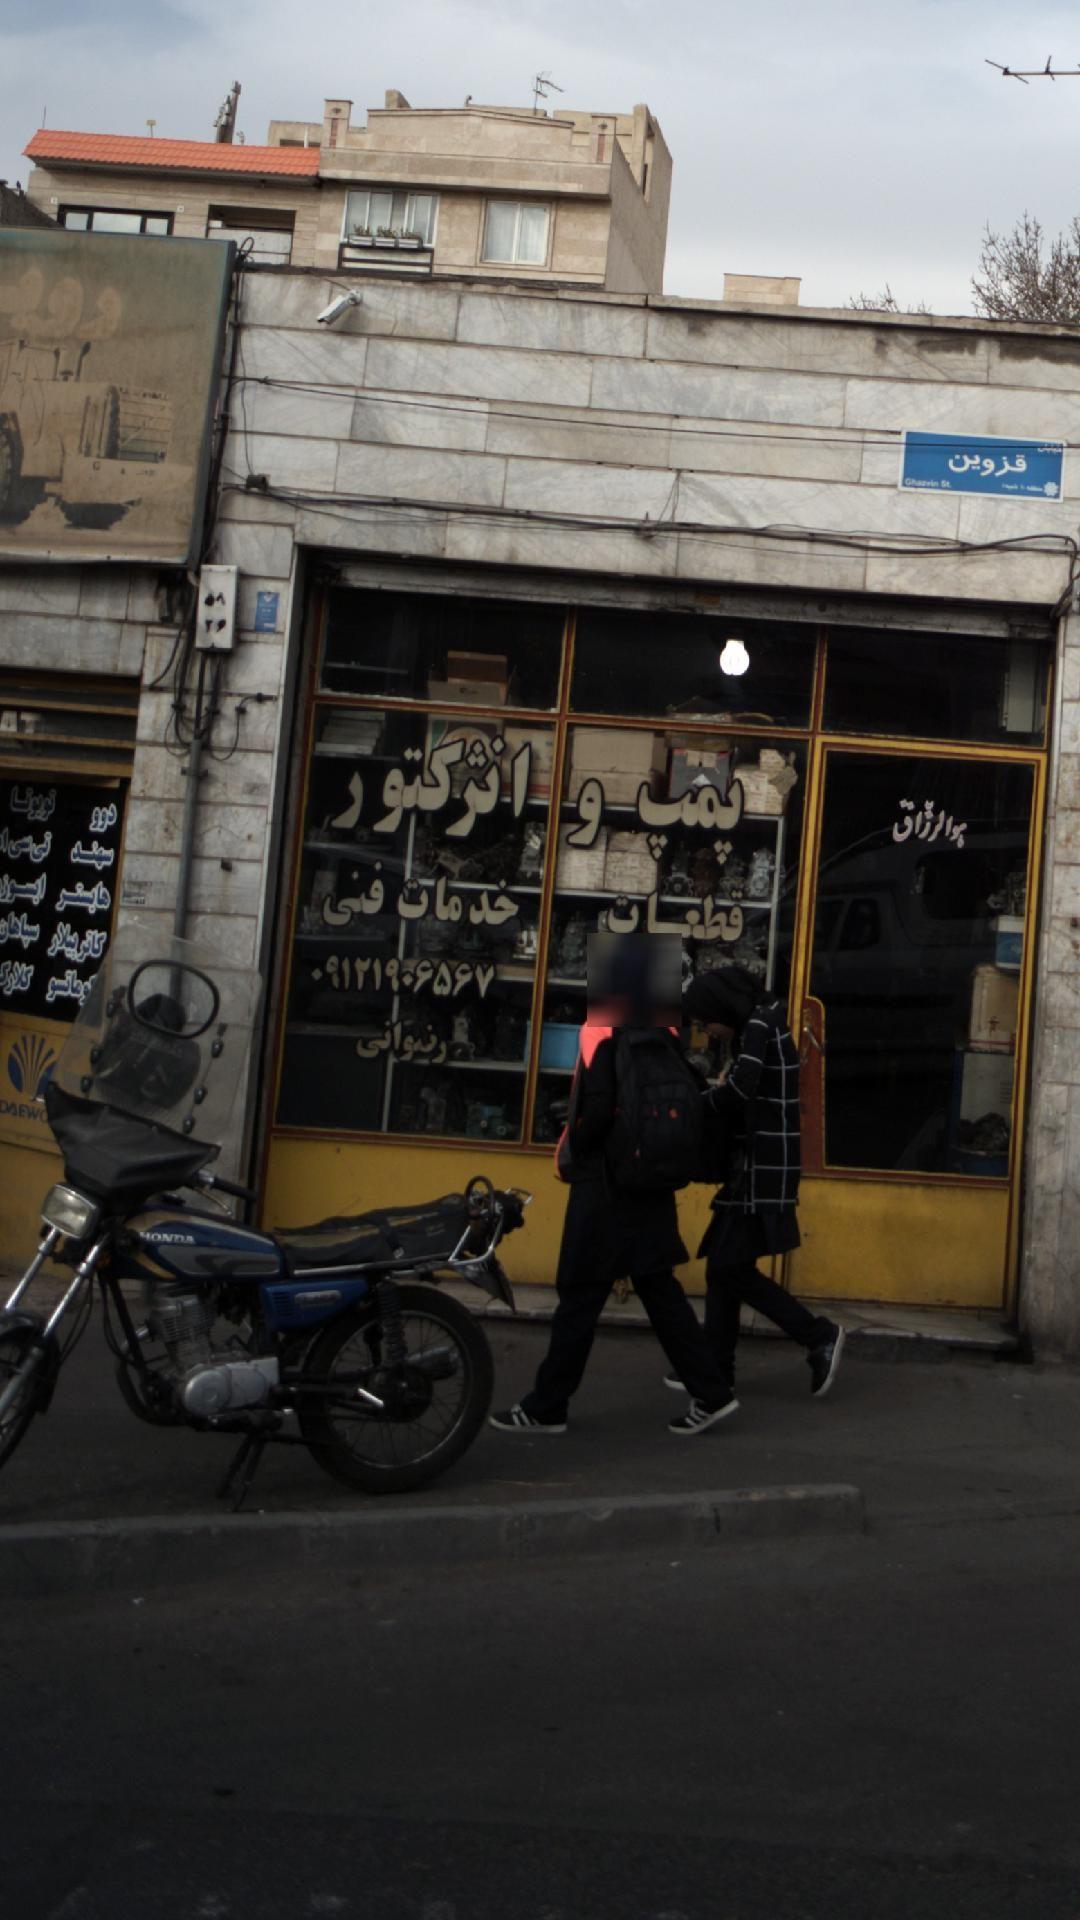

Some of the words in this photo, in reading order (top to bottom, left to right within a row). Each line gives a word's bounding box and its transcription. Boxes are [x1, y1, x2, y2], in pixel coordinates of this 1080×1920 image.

[948, 453, 1028, 477] قزوین
[329, 734, 533, 838] انژکتور
[88, 802, 118, 833] دوو
[566, 778, 605, 848] و
[637, 778, 745, 866] پمپ
[70, 840, 116, 871] سهند
[0, 872, 47, 906] ایسوز
[322, 860, 385, 927] فنی
[397, 876, 519, 926] خدمات
[607, 890, 744, 942] قطعات
[355, 1020, 448, 1065] رضوانی
[139, 1231, 196, 1245] HONDA
